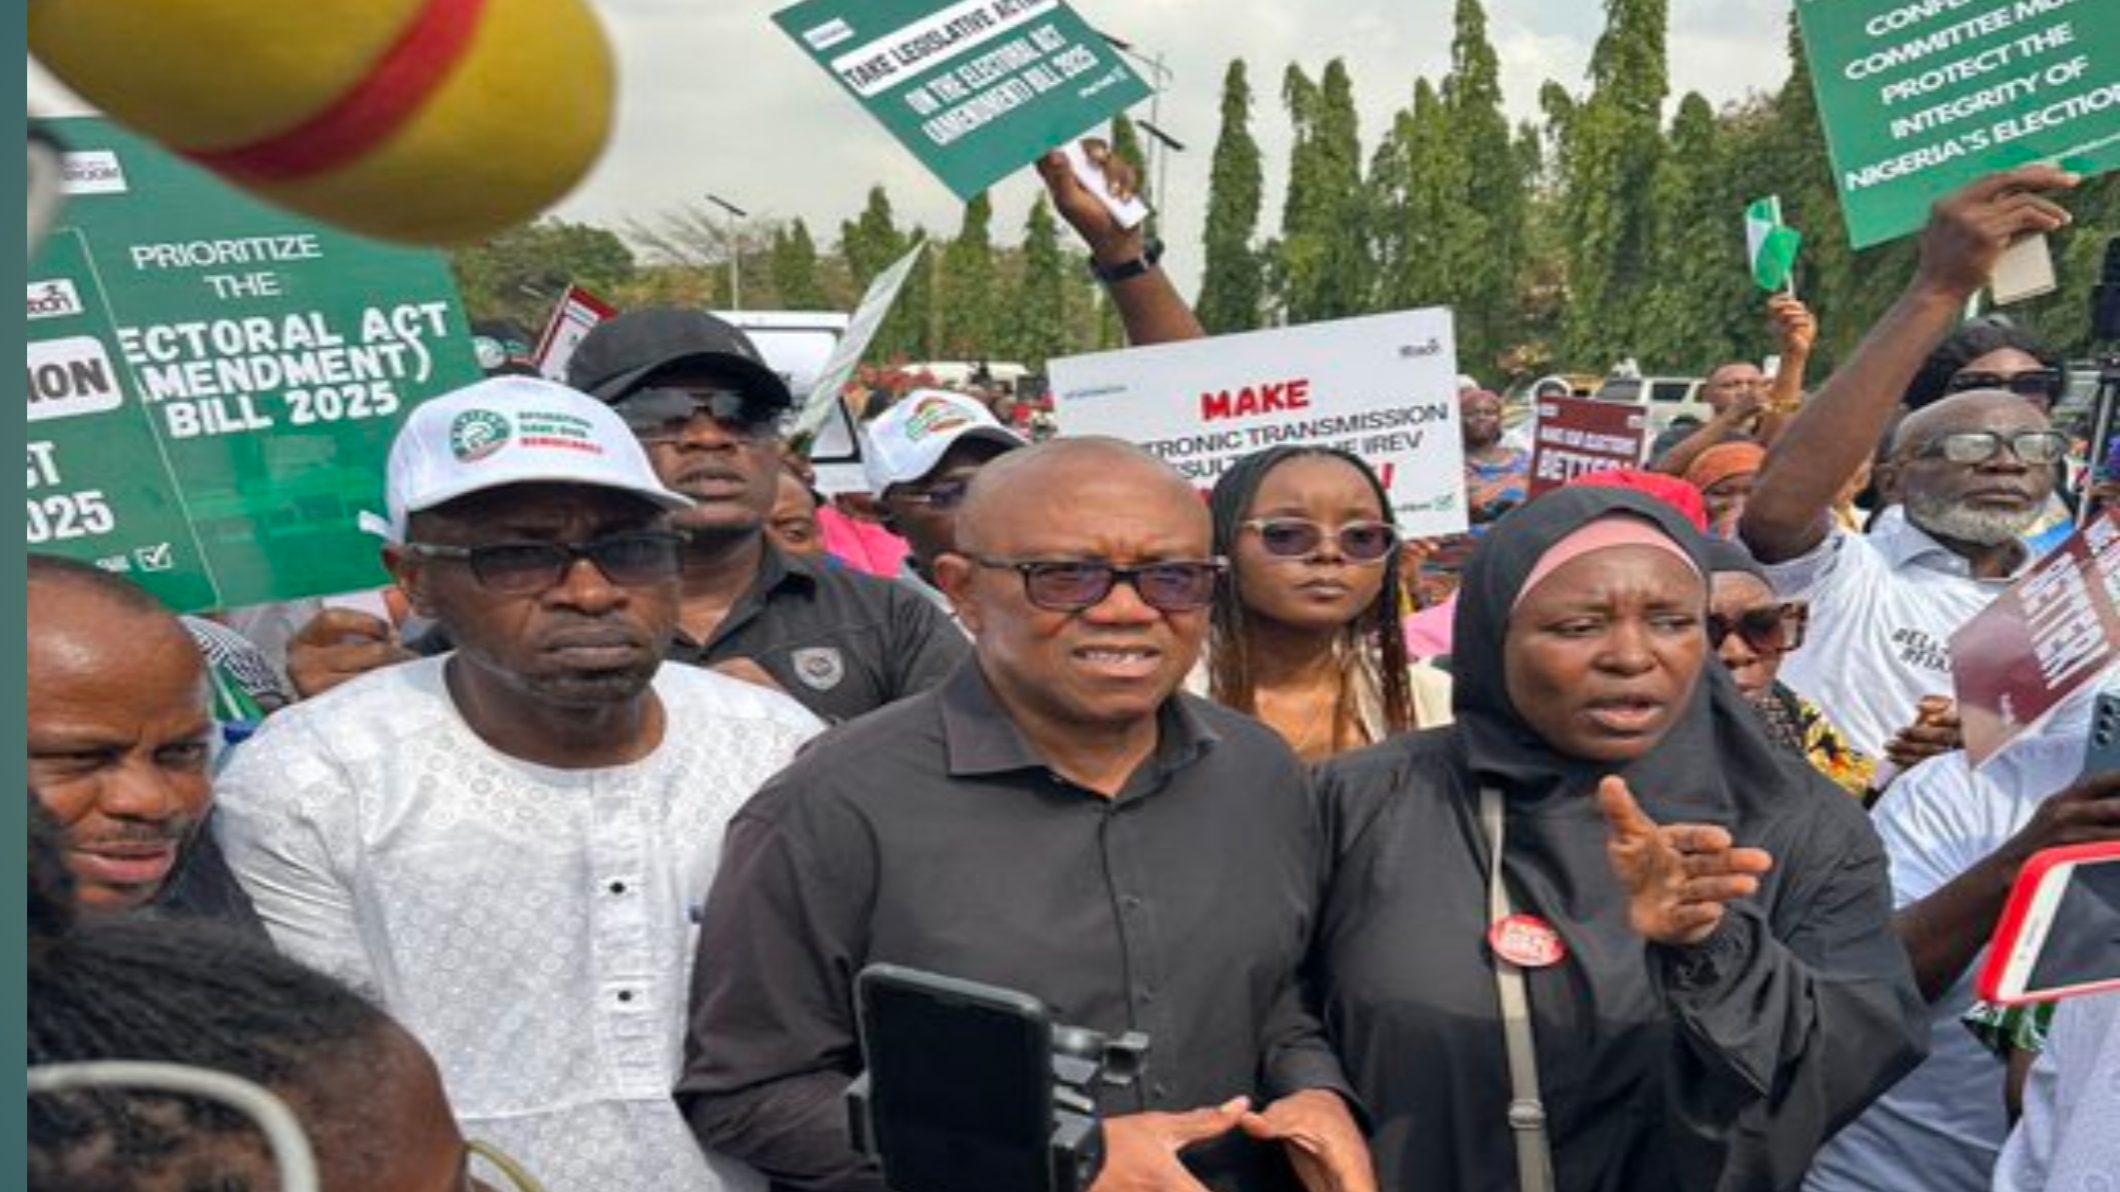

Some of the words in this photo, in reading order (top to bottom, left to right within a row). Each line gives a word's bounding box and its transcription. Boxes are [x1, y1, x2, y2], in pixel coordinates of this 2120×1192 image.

[842, 53, 898, 88] TAKE
[889, 8, 996, 66] LEGISLATIVE
[1844, 7, 2013, 80] COMMITTEE
[1881, 45, 2012, 105] PROTECT
[2015, 21, 2076, 57] THE
[1889, 73, 2040, 140] INTEGRITY
[2045, 55, 2090, 86] OF
[1844, 129, 1991, 191] NIGERIA'S
[130, 233, 324, 270] PRIORITIZE
[203, 271, 282, 300] THE
[115, 311, 344, 364] ECTORAL
[362, 300, 449, 344] ACT
[141, 331, 432, 401] MENDMENT)
[165, 395, 275, 439] BILL
[284, 380, 400, 425] 2025
[1200, 378, 1311, 422] MAKE
[1246, 402, 1449, 446] TRANSMISSION
[27, 490, 115, 544] 025
